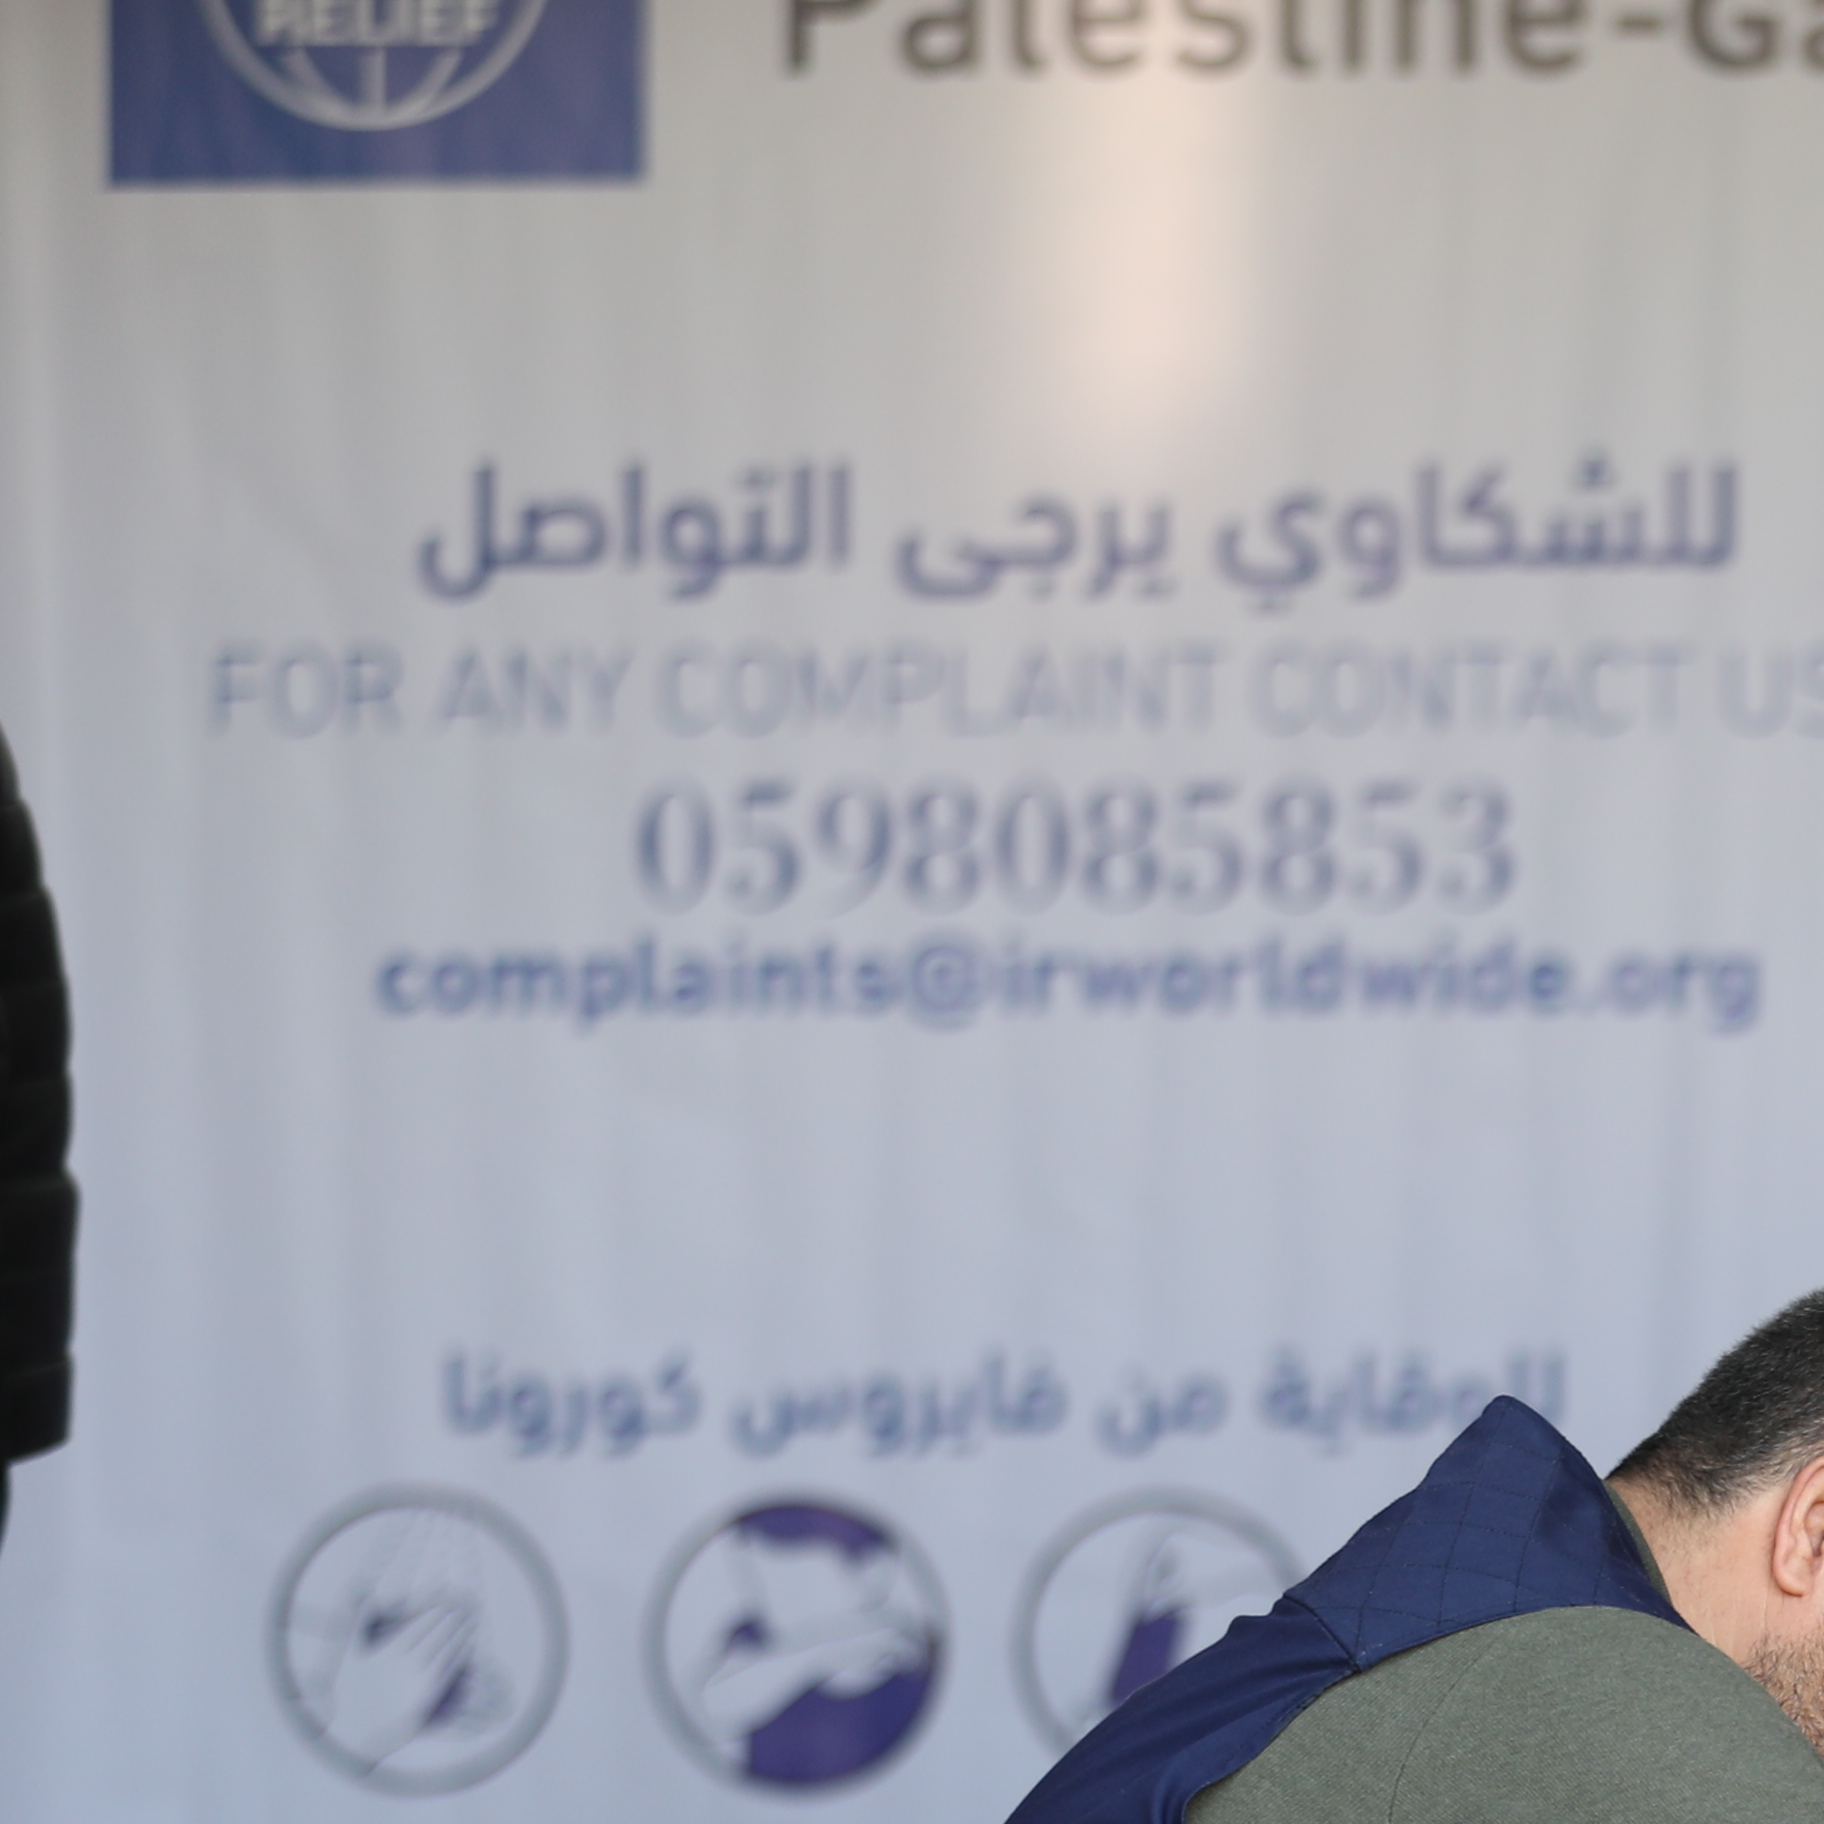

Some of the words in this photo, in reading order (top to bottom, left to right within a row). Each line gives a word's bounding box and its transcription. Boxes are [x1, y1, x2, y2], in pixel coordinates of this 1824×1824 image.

[418, 458, 856, 602] التواصل
[894, 484, 1176, 602] يرجى
[1214, 450, 1744, 615] للشكاوي
[206, 638, 406, 742] FOR
[438, 640, 632, 740] ANY
[656, 638, 1232, 742] COMPLAINT
[1247, 640, 1697, 742] CONTACT
[634, 779, 1516, 919] 0598085853
[375, 936, 1763, 1031] complaints@irworldwide.org
[438, 1352, 702, 1462] كورونا
[726, 1352, 1070, 1460] فايروس
[1098, 1360, 1232, 1458] من
